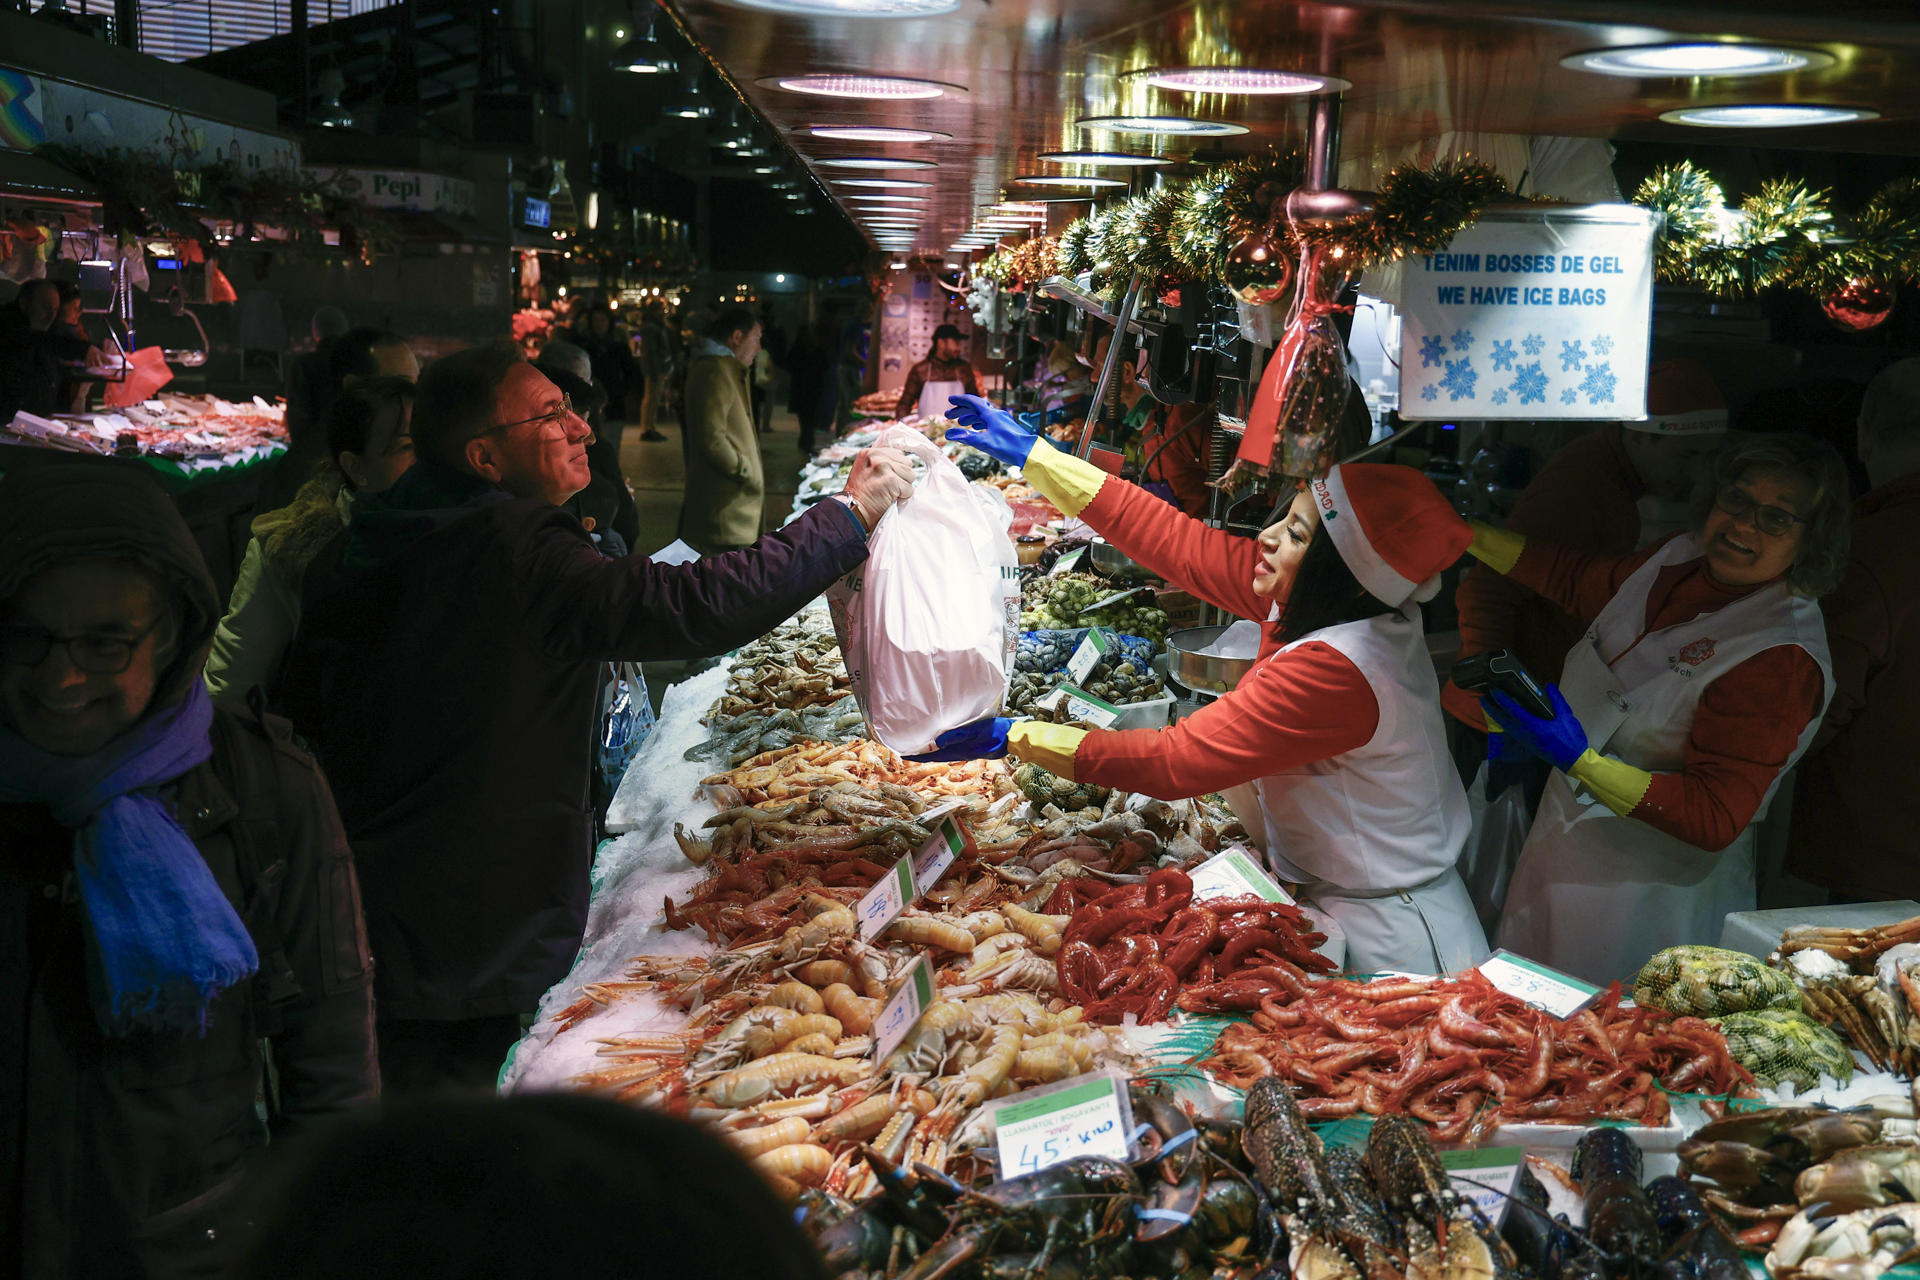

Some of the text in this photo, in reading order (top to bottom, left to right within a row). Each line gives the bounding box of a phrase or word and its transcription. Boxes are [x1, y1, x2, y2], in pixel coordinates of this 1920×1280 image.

[373, 174, 421, 202] Pepi
[1424, 253, 1624, 274] TENIM BOSSES DE GEL
[1437, 286, 1607, 306] WE HAVE ICE BAGS
